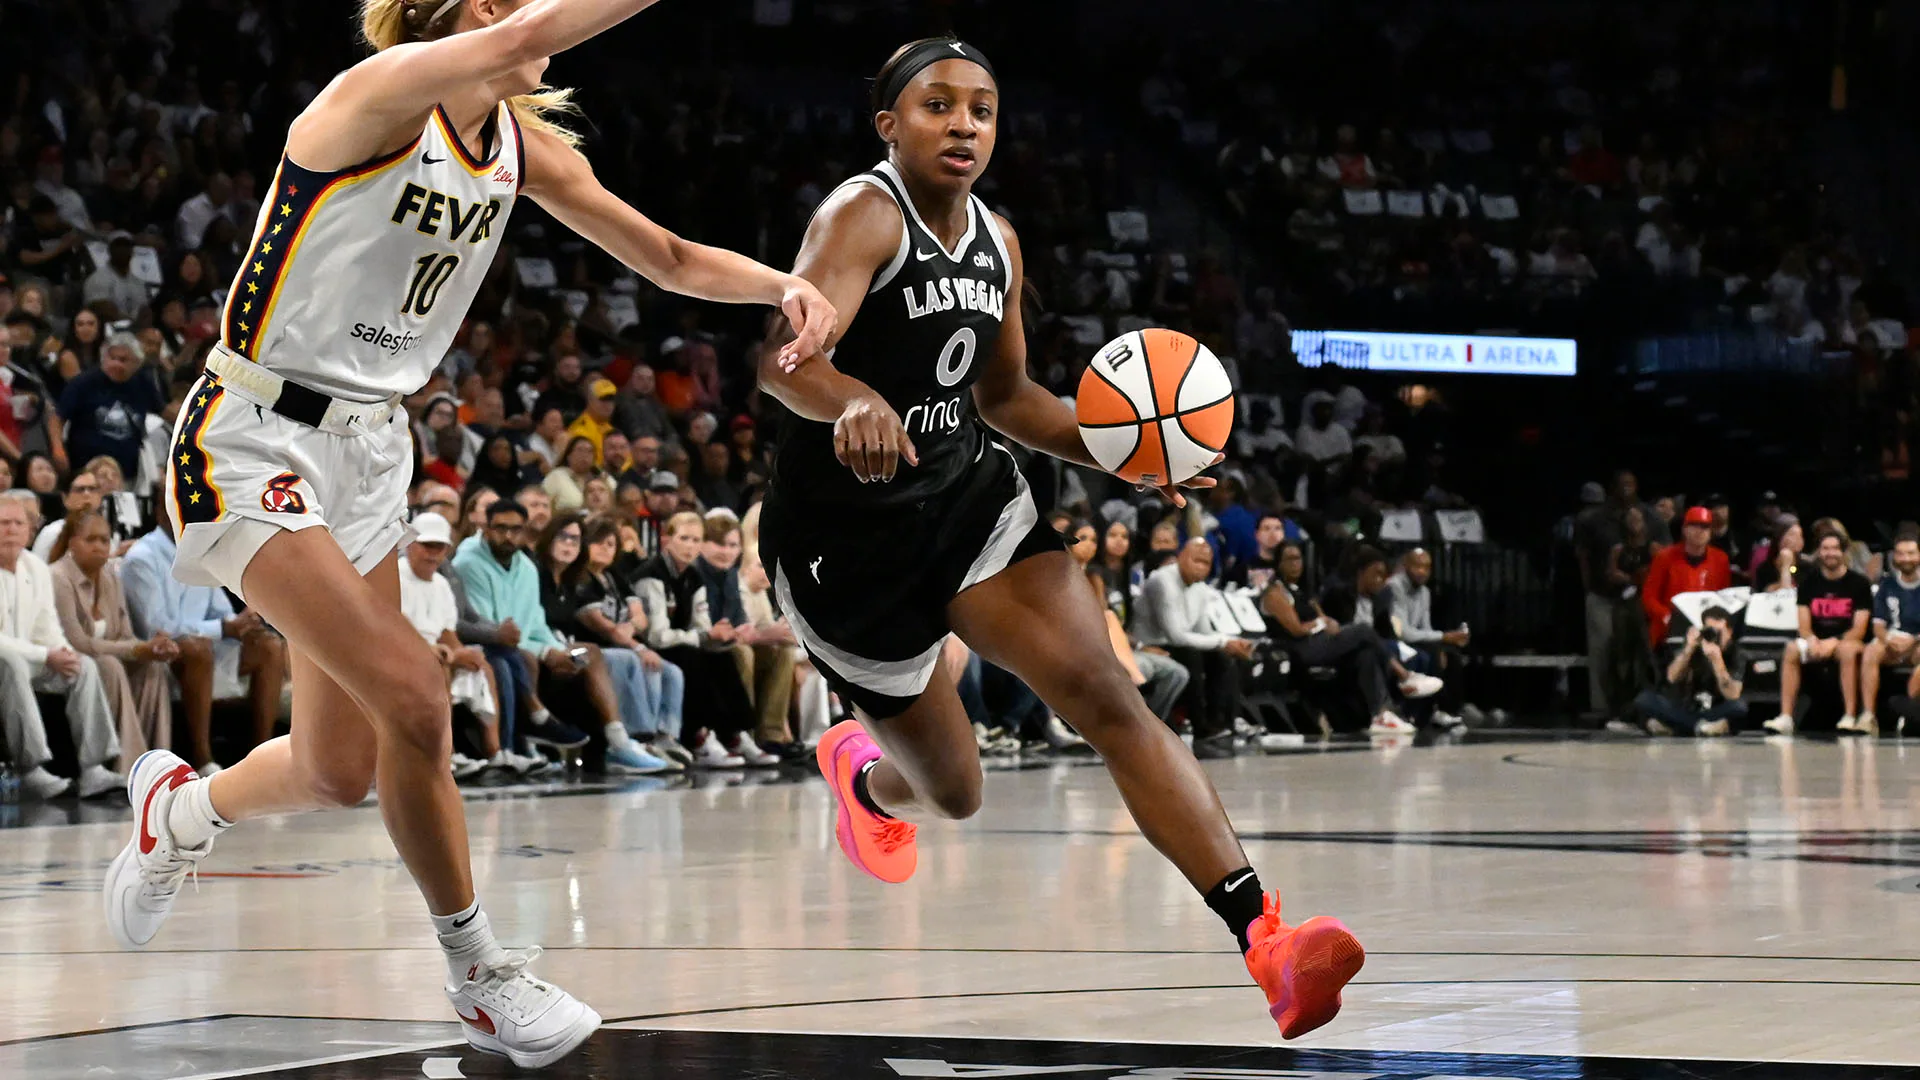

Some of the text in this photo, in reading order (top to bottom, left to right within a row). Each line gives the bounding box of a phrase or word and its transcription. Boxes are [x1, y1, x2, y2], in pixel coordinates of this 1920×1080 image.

[973, 251, 995, 271] ally
[400, 251, 460, 317] 10
[902, 277, 955, 319] LAS
[936, 327, 977, 387] 0
[1380, 341, 1456, 362] ULTRA
[1483, 345, 1560, 366] ARENA
[903, 396, 961, 435] ring
